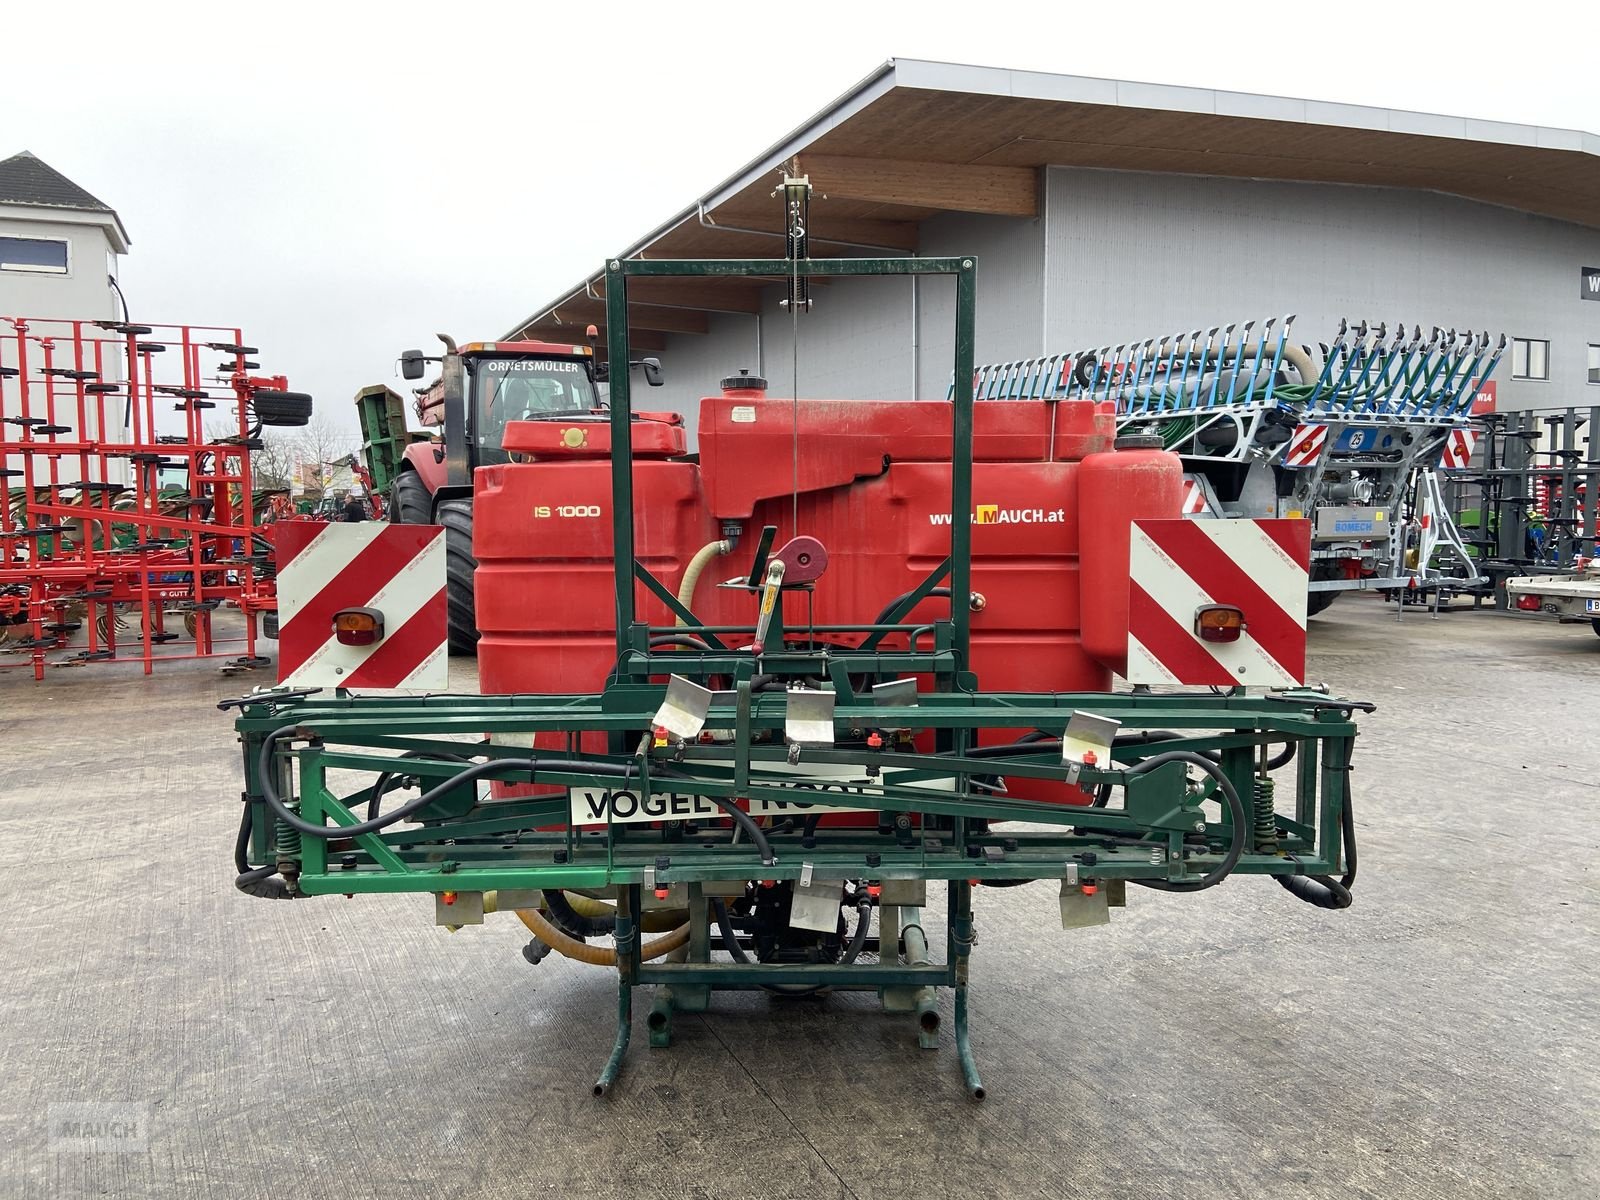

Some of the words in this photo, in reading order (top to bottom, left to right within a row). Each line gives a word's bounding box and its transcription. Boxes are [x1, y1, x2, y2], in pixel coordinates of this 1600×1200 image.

[488, 360, 579, 373] ORNETSMÜLLER
[1476, 392, 1493, 402] W14
[1351, 433, 1363, 446] 25
[534, 506, 551, 518] IS
[555, 505, 601, 518] 1000
[584, 790, 712, 818] VOGEL
